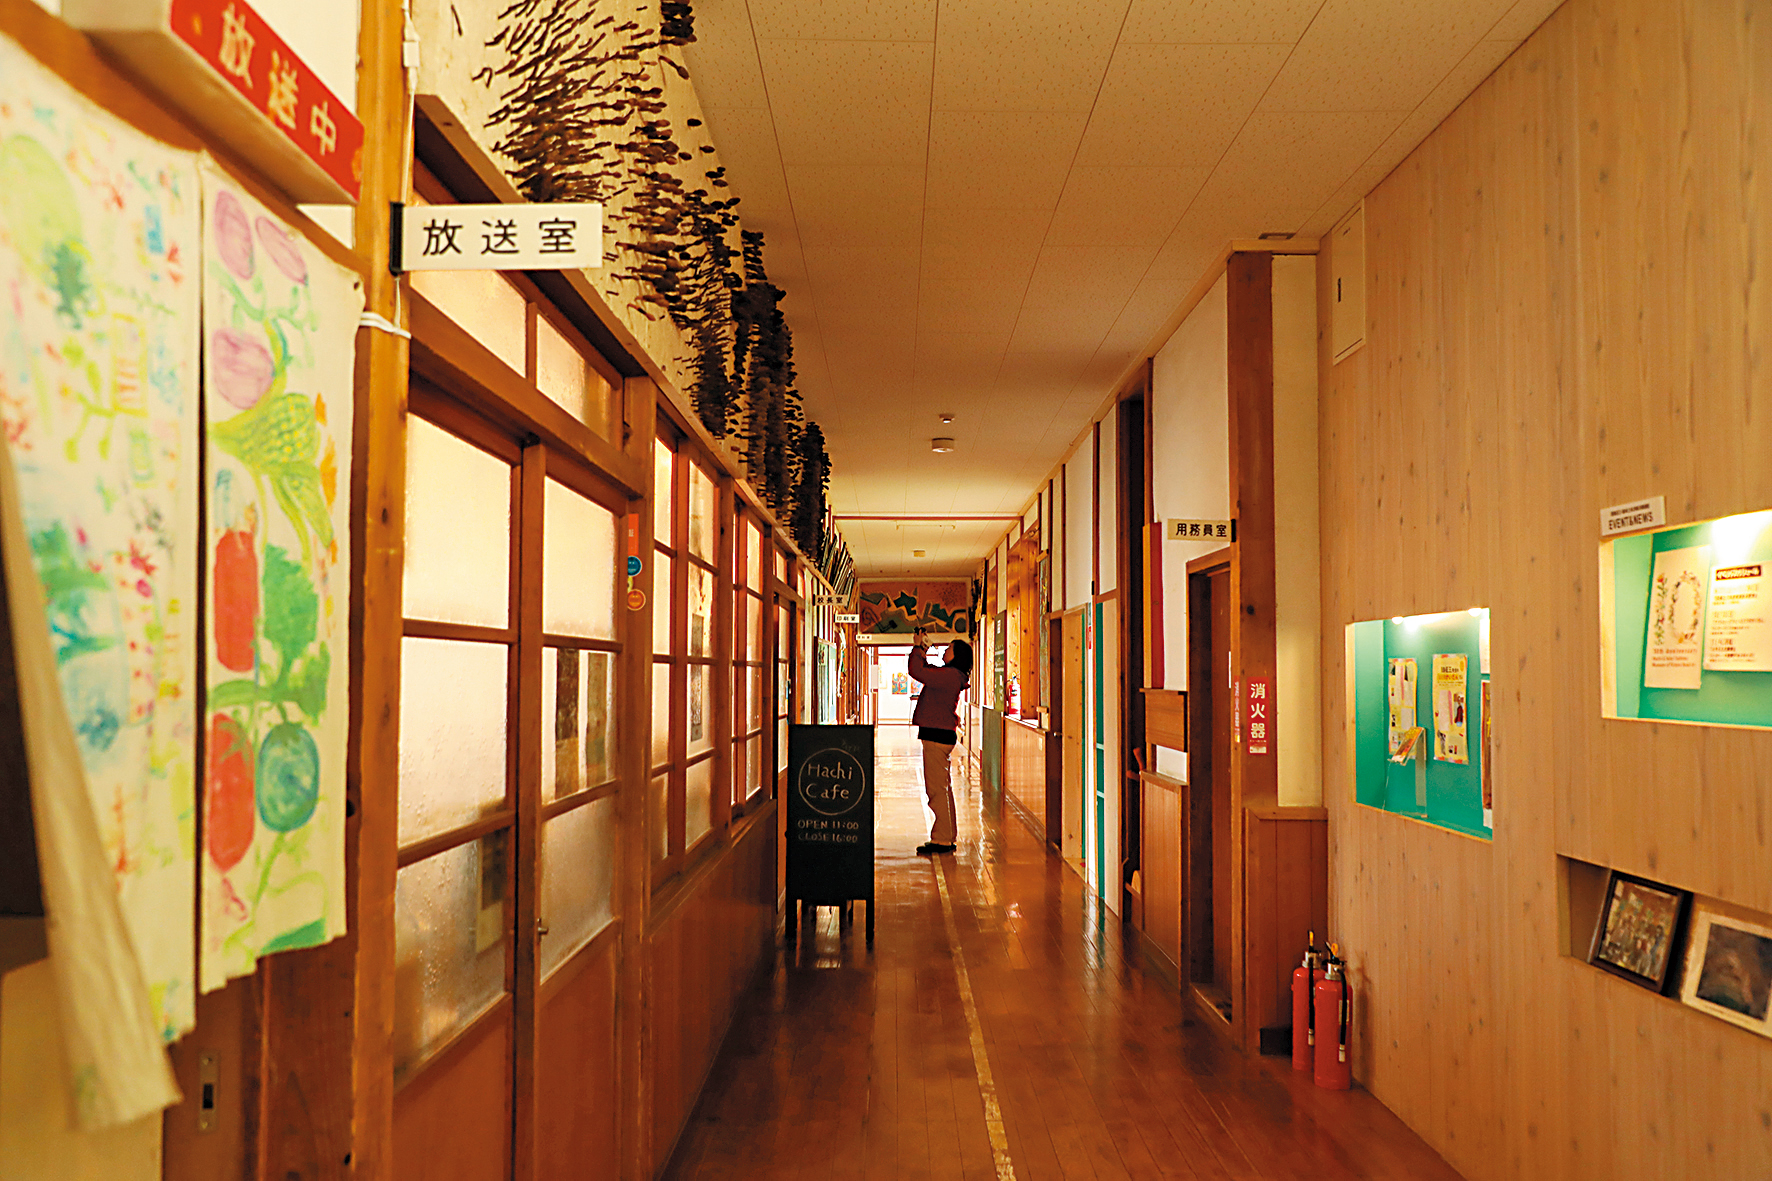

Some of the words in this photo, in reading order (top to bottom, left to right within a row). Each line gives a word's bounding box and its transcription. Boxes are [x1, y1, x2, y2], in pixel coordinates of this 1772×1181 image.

[219, 2, 337, 156] 放送中
[422, 217, 577, 257] 放送室
[1175, 522, 1227, 537] 用務員室
[817, 596, 844, 604] 校長室
[1250, 683, 1266, 739] 消火器
[807, 761, 853, 780] Hachi
[805, 782, 850, 800] Cafe
[797, 819, 828, 830] OPEN
[832, 820, 859, 830] 11:00
[798, 832, 829, 842] CLOSE
[832, 832, 858, 843] 16:00
